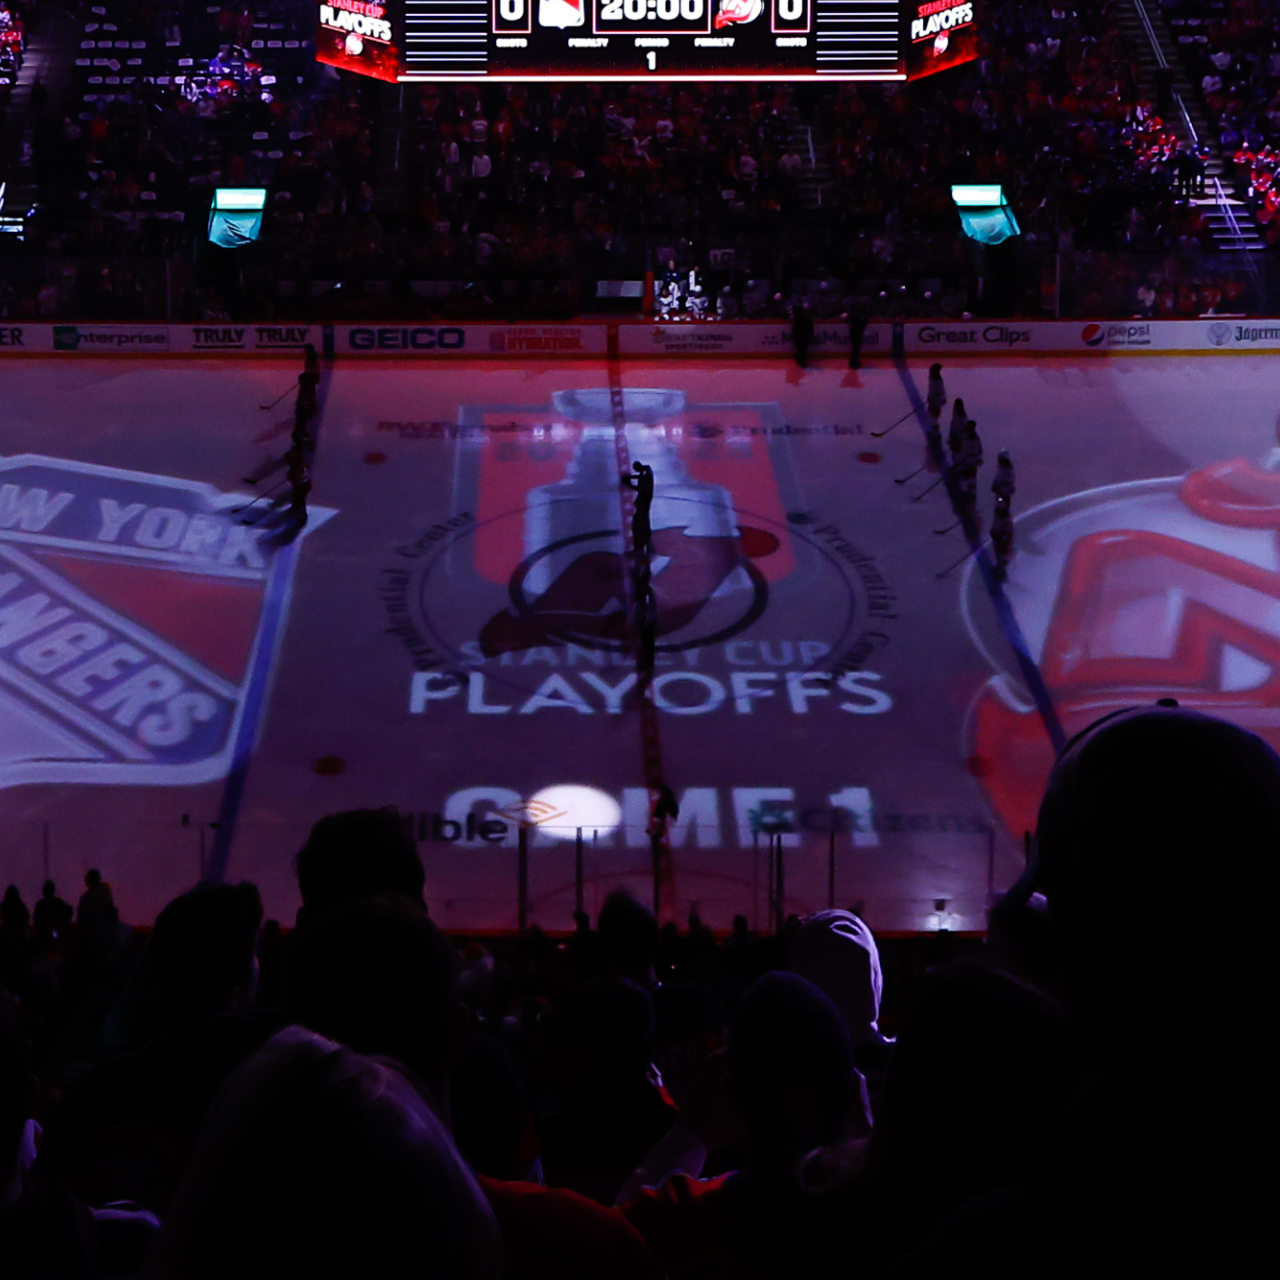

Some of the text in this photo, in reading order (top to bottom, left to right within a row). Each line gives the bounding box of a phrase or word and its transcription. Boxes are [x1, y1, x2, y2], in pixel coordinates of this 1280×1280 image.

[320, 3, 392, 42] PLAYOFFS
[366, 5, 385, 19] CUP
[911, 2, 973, 40] PLAYOFFS
[568, 37, 609, 48] PENALTY
[694, 37, 735, 48] PENALTY
[646, 51, 657, 71] 1
[193, 328, 245, 344] TRULY
[256, 328, 309, 344] TRULY
[348, 328, 465, 350] GEICO
[918, 325, 1032, 348] Great Clips
[1107, 324, 1150, 340] pepsi
[95, 497, 274, 569] YORK
[725, 639, 834, 667] CUP
[407, 671, 895, 715] PLAYOFFS
[443, 786, 881, 849] GME 1
